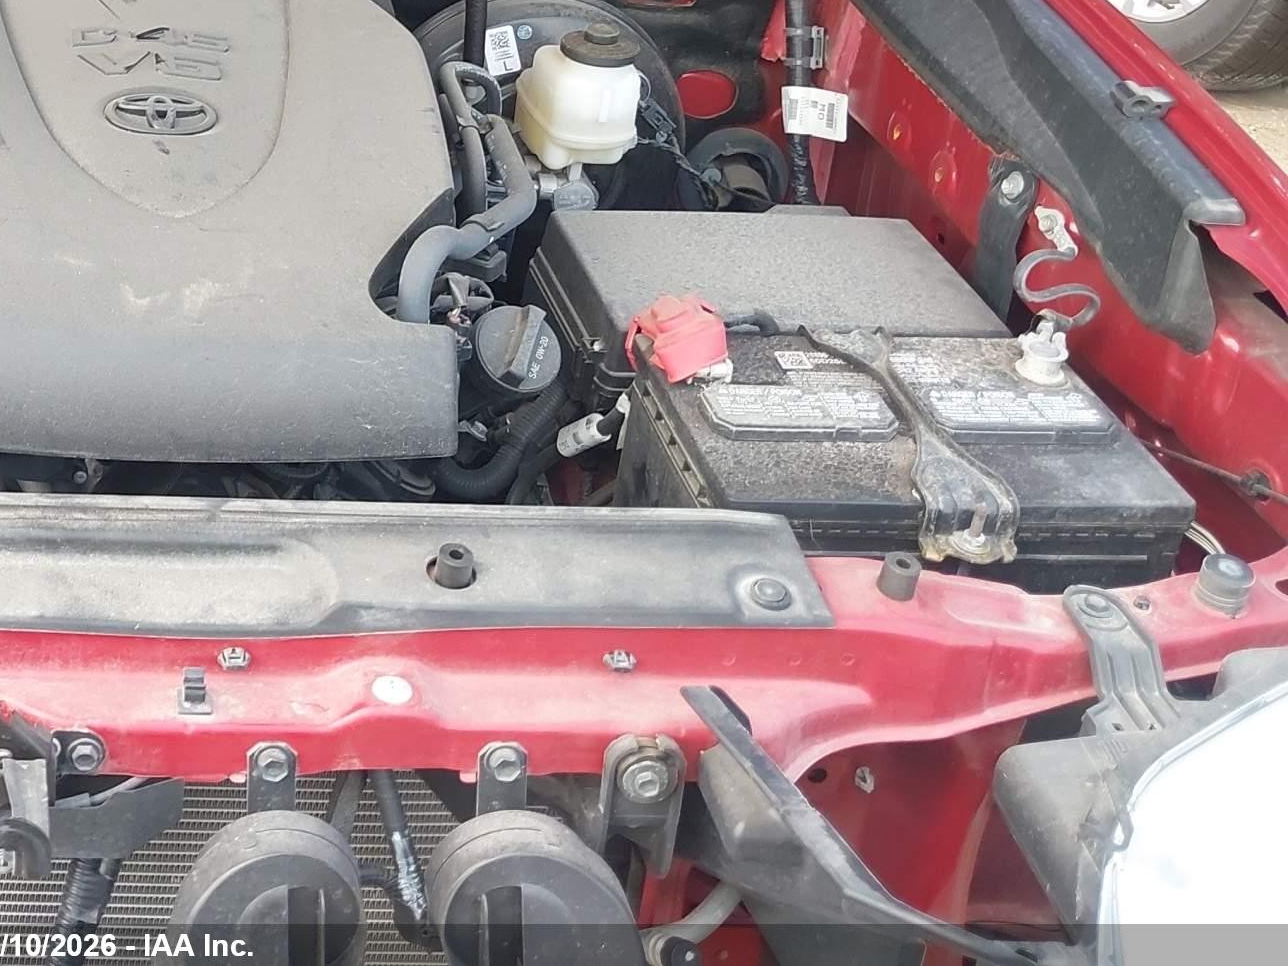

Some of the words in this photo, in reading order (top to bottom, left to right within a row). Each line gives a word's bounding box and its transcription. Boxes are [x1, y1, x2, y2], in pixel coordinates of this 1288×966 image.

[77, 49, 224, 81] V6
[528, 361, 541, 379] SAE
[535, 336, 549, 360] 0W-20
